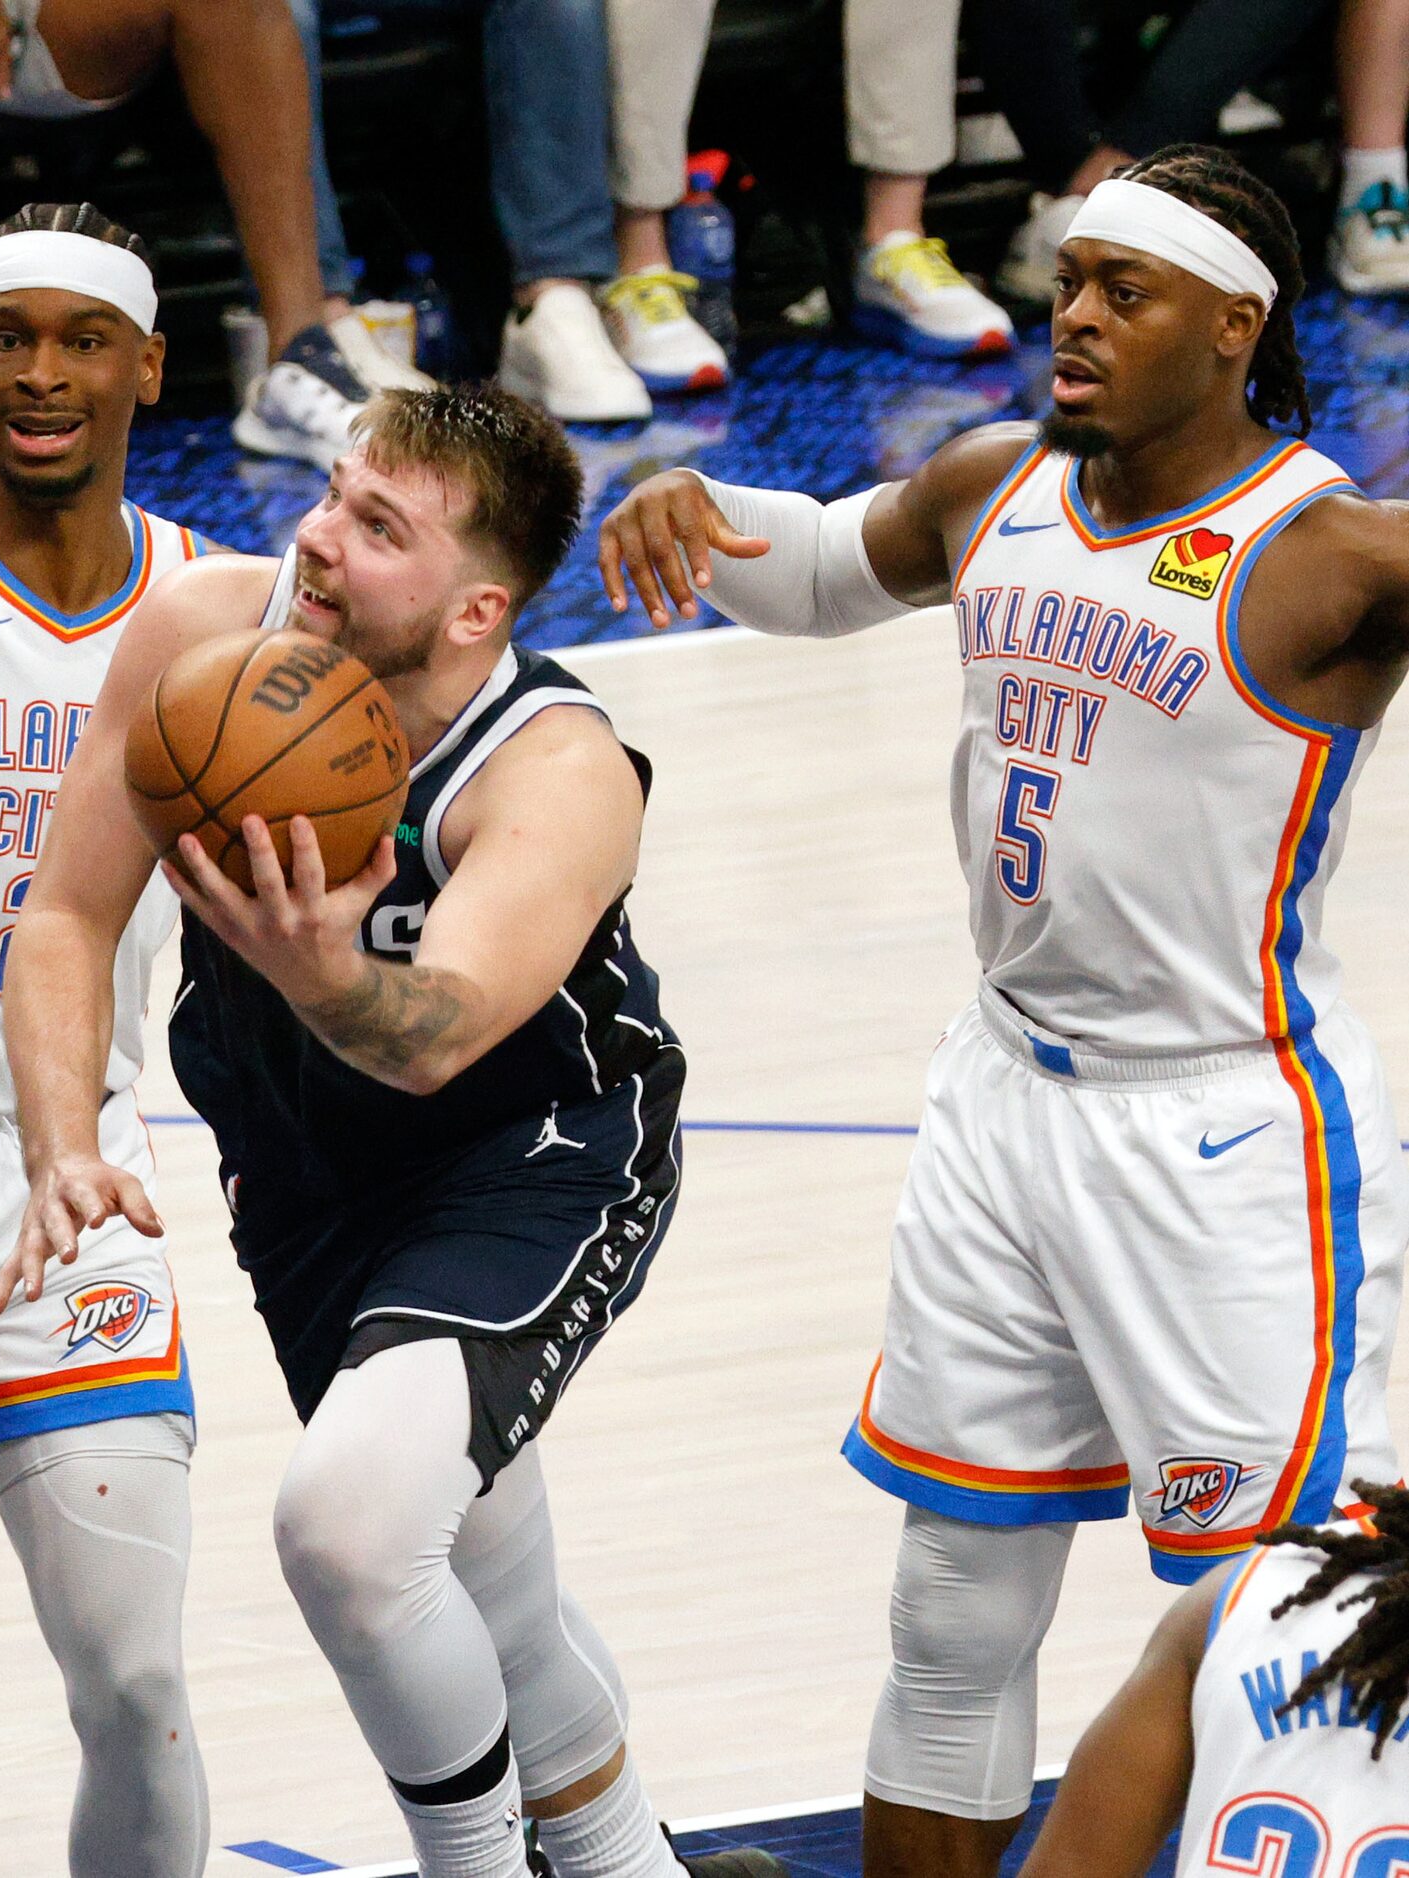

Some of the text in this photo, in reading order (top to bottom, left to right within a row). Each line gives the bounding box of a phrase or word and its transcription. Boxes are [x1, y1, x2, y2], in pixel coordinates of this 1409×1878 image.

[955, 586, 1212, 721] OKLAHOMA
[995, 672, 1107, 765] CITY
[995, 758, 1062, 907] 5
[73, 1292, 136, 1339] OKC
[1165, 1466, 1223, 1509] OKC
